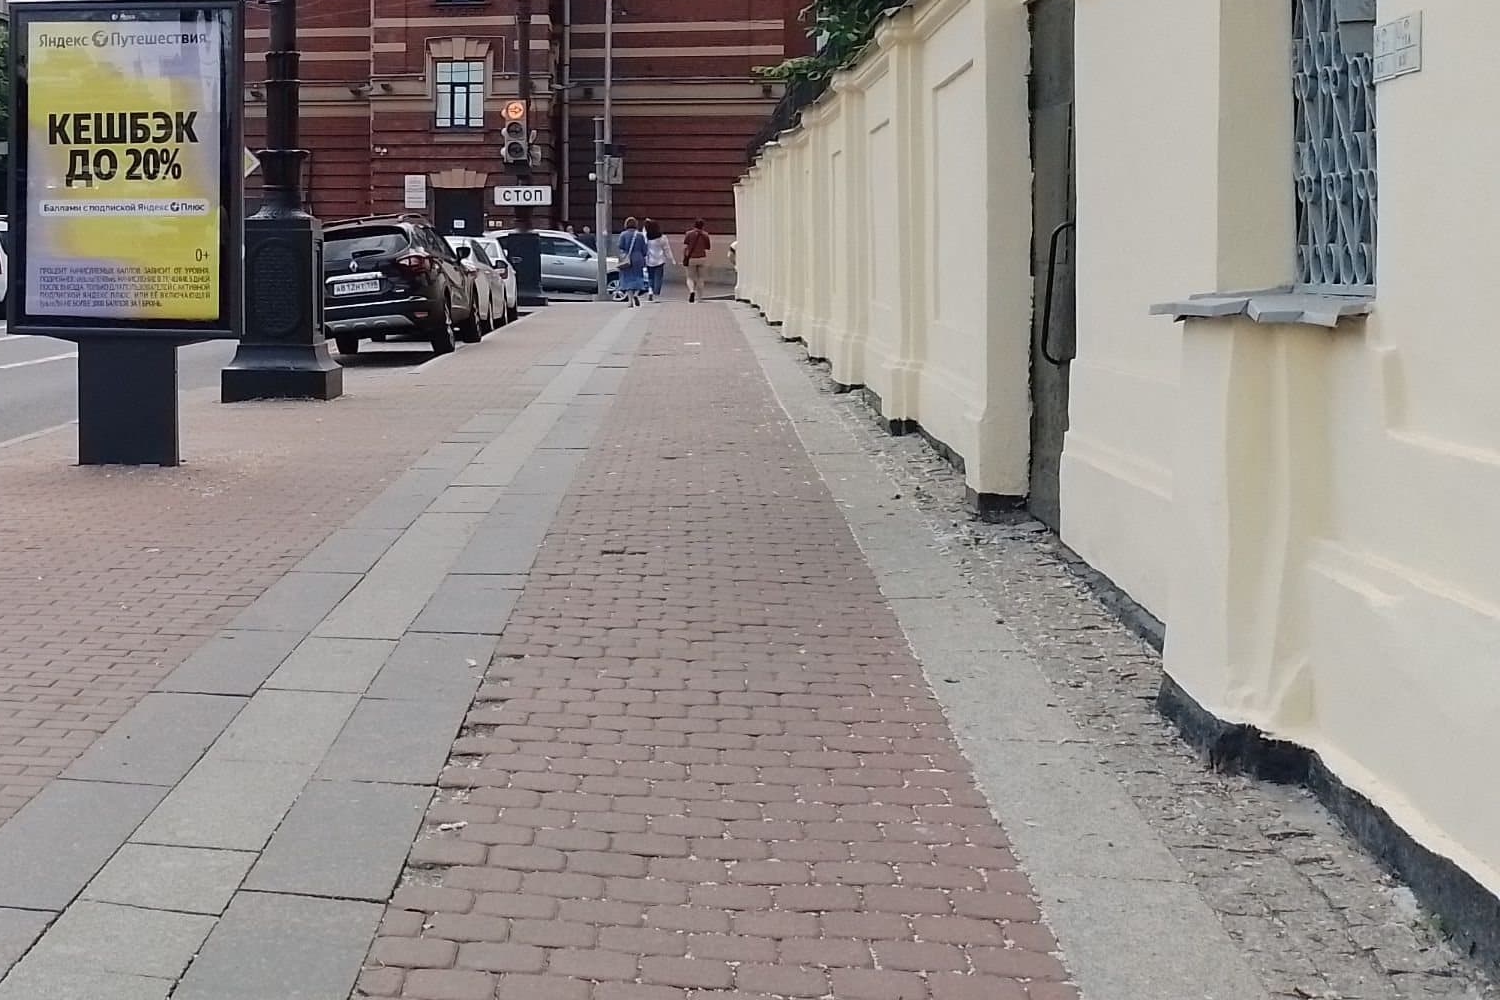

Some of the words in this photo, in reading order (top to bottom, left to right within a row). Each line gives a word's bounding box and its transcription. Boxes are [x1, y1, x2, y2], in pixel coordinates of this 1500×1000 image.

[39, 33, 88, 48] Яндекс
[111, 32, 207, 48] Путешествия
[48, 111, 199, 145] КЕШБЭК
[65, 149, 118, 187] ДО
[125, 148, 182, 180] 20%
[502, 189, 544, 202] СТОП
[43, 203, 82, 213] Баллами
[89, 202, 136, 214] подпиской
[138, 203, 169, 213] Яндекс
[180, 202, 205, 212] Плюс
[194, 248, 211, 262] 0+
